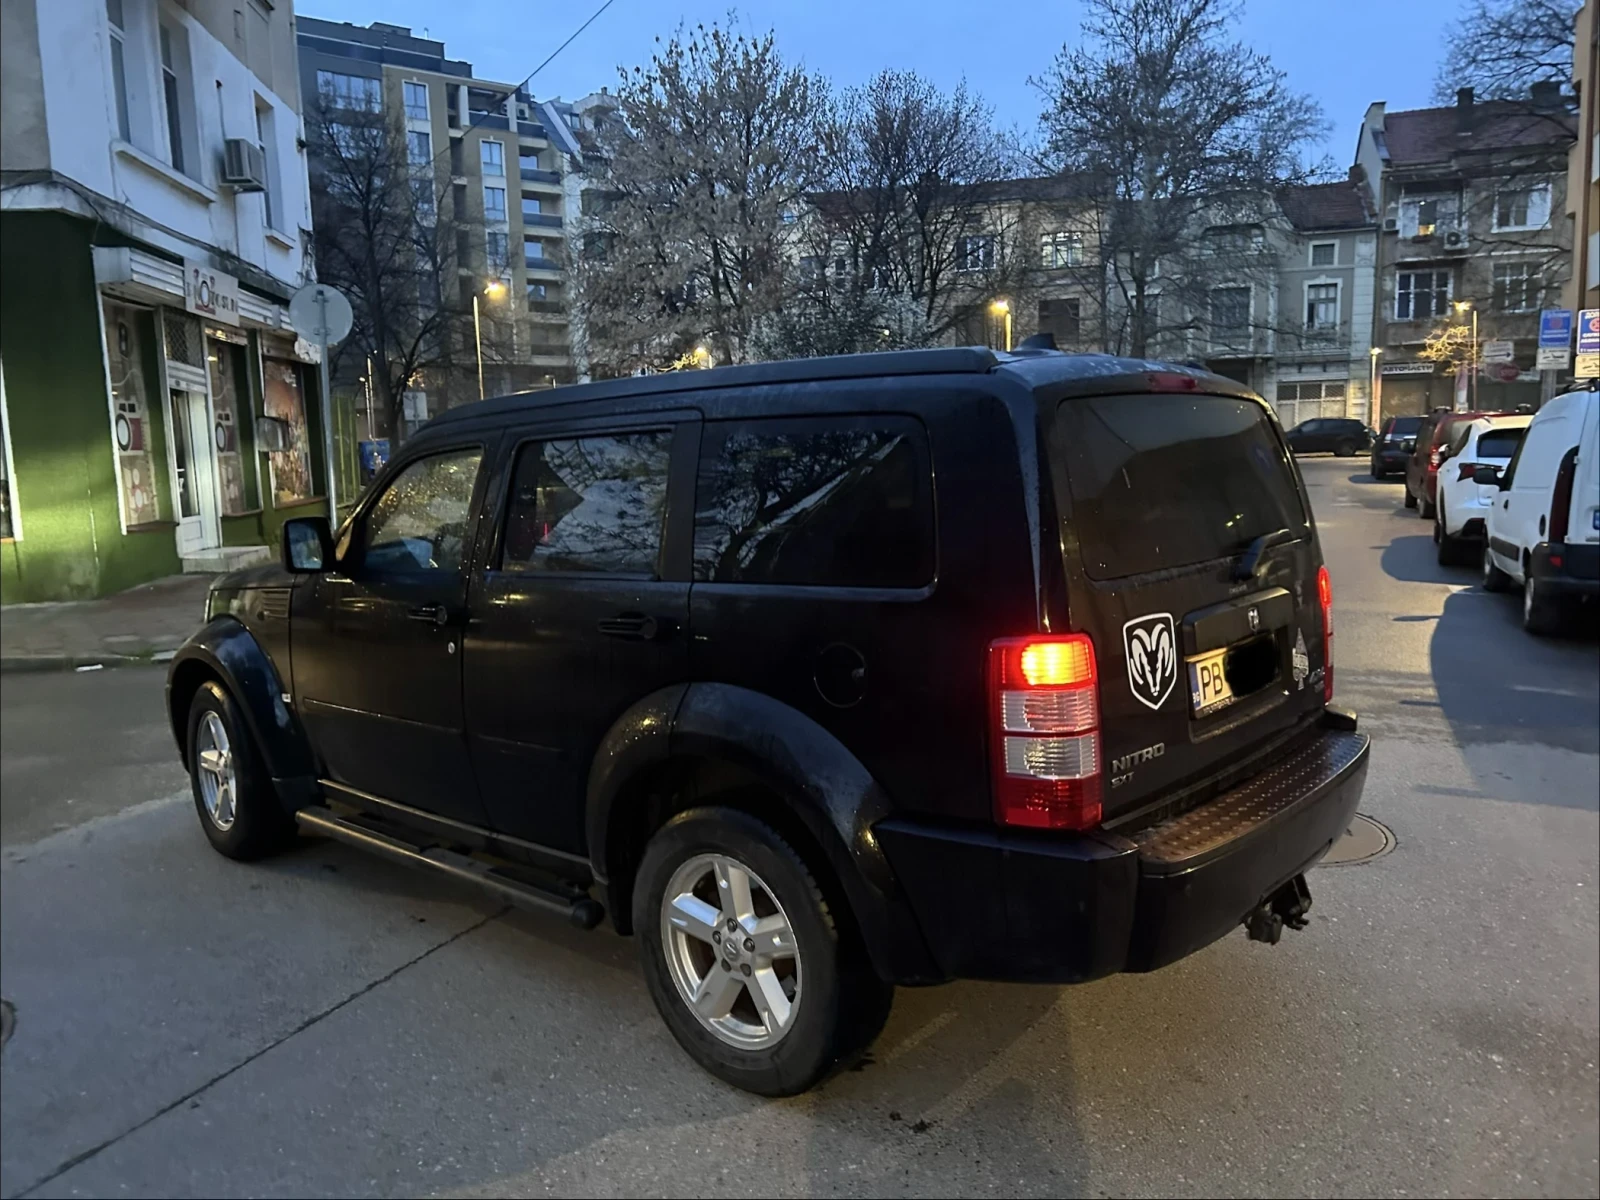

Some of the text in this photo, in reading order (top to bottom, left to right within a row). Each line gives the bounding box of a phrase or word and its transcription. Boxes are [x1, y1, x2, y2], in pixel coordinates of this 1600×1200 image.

[1200, 661, 1223, 700] PB
[1112, 742, 1165, 773] NITRO
[1111, 771, 1134, 789] SXT
